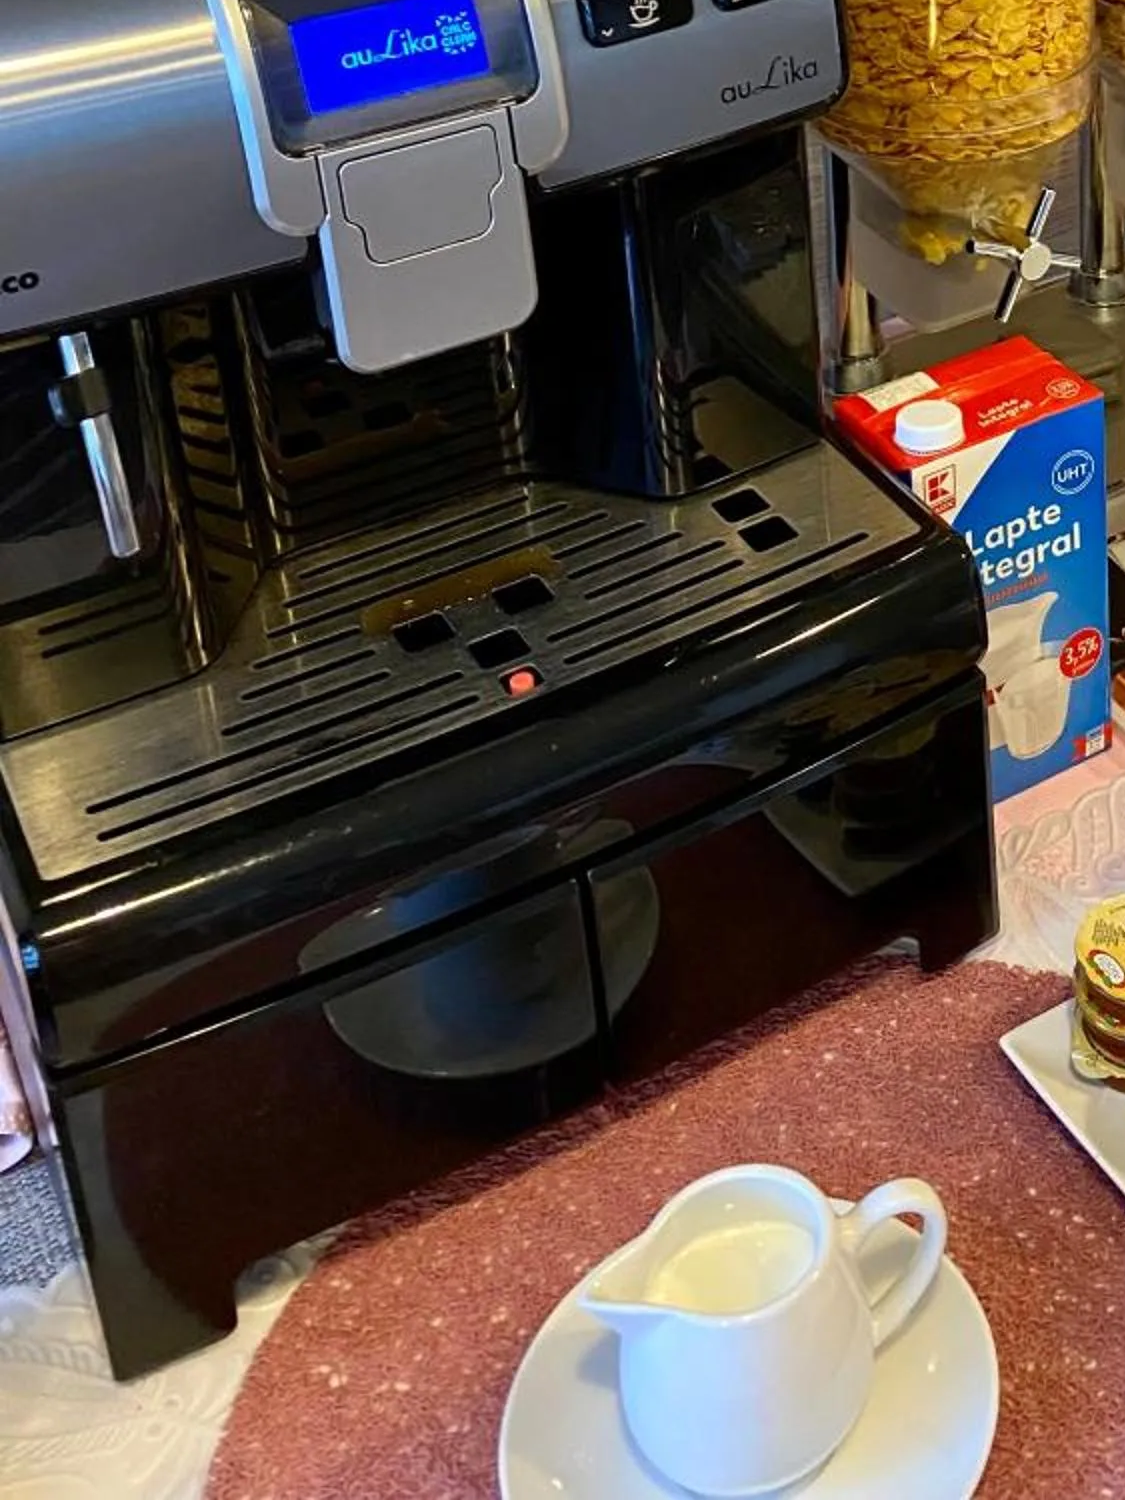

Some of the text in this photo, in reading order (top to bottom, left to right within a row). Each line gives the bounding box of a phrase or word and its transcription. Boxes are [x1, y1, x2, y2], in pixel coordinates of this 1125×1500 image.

[1057, 462, 1089, 483] UHT
[965, 504, 1061, 556] Lapte
[980, 522, 1082, 586] tegral
